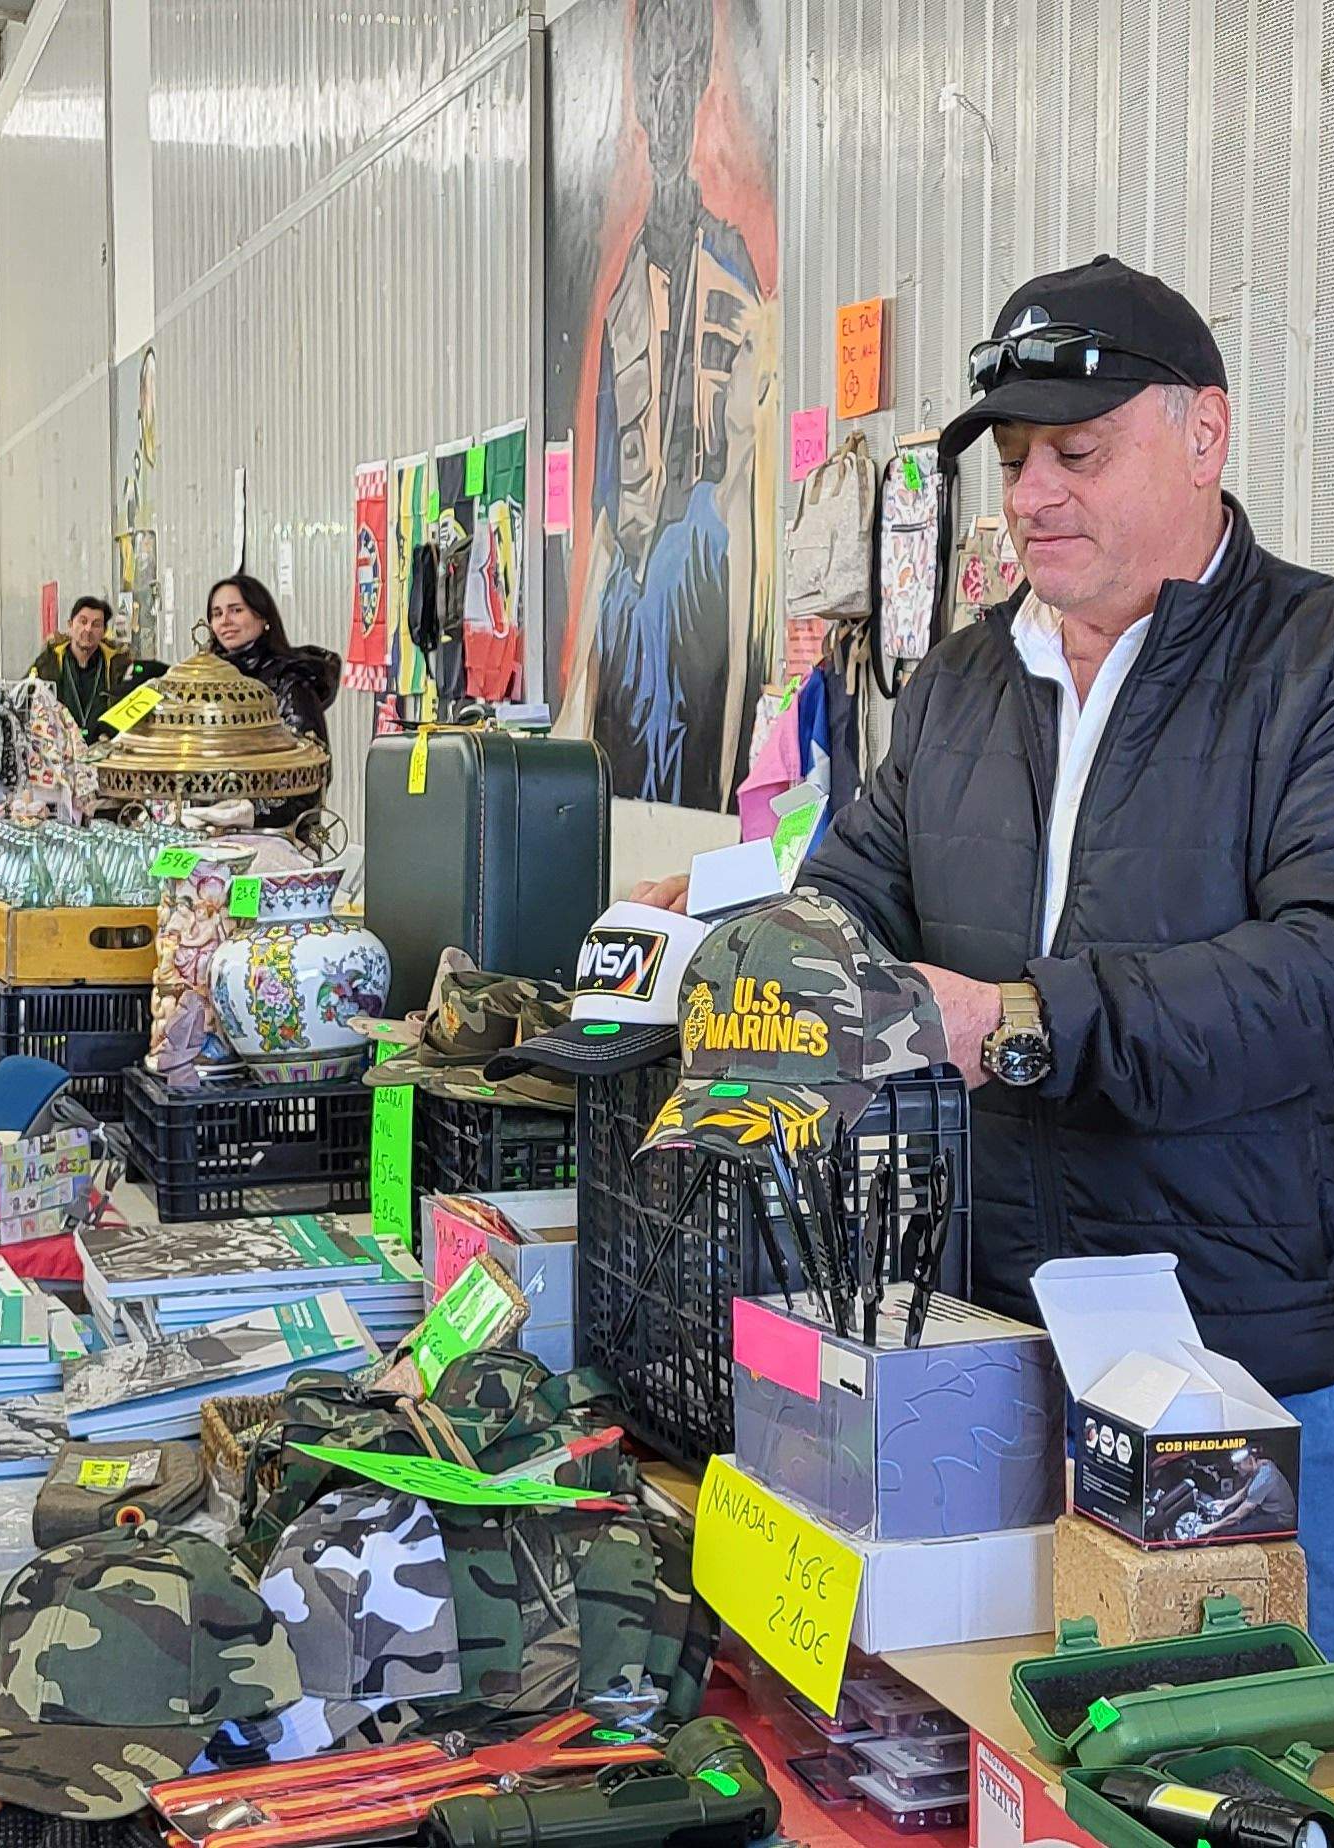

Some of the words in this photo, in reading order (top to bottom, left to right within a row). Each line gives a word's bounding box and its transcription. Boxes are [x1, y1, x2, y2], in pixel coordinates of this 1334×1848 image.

[733, 976, 791, 1016] U.S.
[704, 1012, 829, 1058] MARINES
[1155, 1440, 1183, 1454] COB
[1186, 1437, 1248, 1453] HEADLAMP
[704, 1473, 778, 1543] NAVAJAS
[784, 1532, 836, 1600] 1-6€
[768, 1594, 831, 1666] 2-10€
